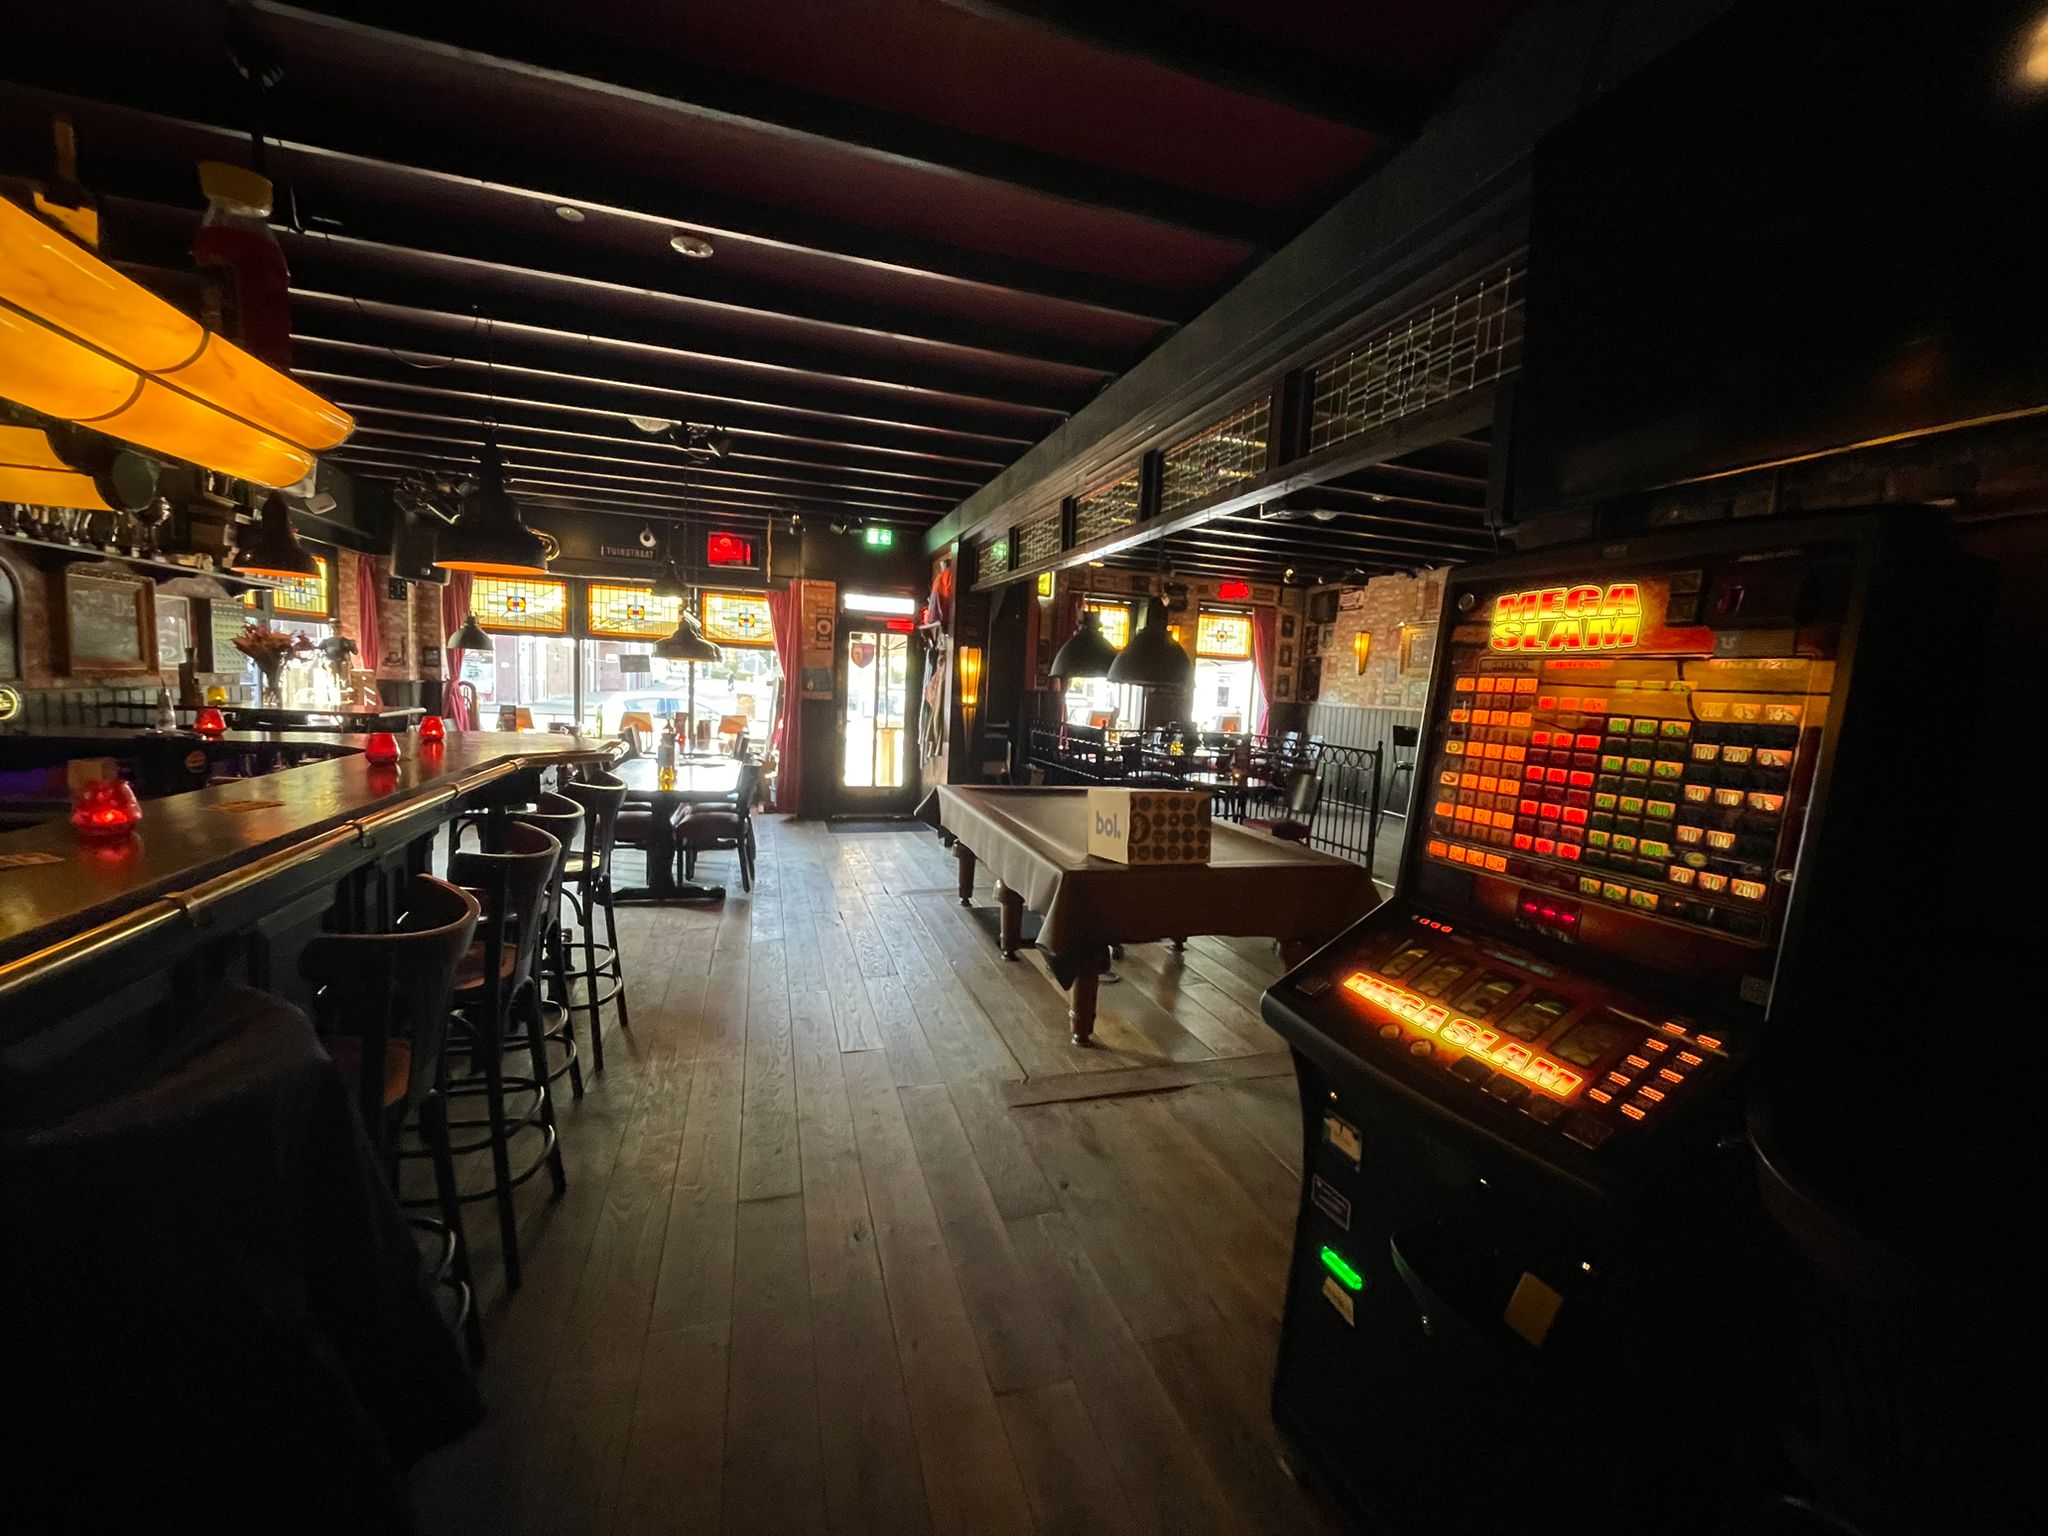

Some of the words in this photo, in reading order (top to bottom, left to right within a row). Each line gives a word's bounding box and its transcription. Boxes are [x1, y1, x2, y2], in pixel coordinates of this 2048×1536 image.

[606, 546, 654, 558] TUINSTRAAT
[1494, 584, 1642, 624] MEGA
[1491, 616, 1642, 651] SLAM
[1096, 811, 1121, 839] bol.
[1672, 871, 1689, 883] 20
[1734, 883, 1759, 899] 200
[1343, 972, 1449, 1034] MEGA
[1441, 1019, 1583, 1097] SLAM
